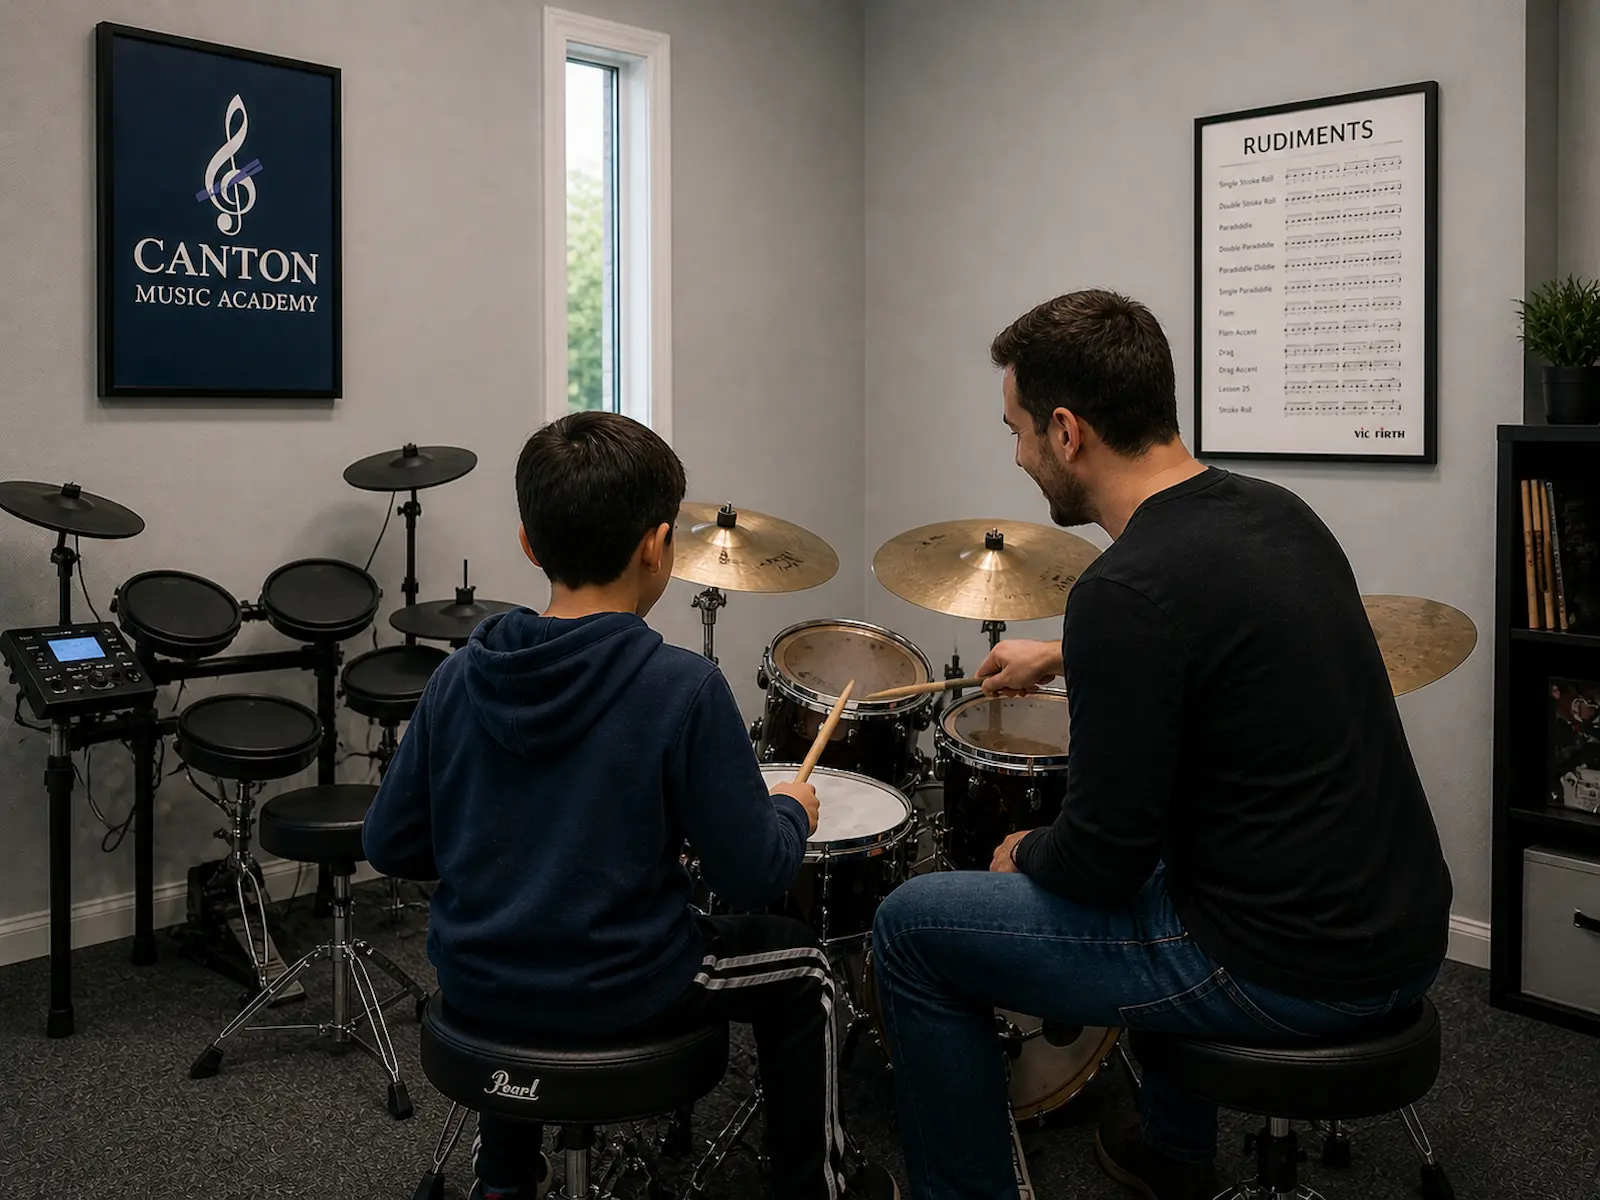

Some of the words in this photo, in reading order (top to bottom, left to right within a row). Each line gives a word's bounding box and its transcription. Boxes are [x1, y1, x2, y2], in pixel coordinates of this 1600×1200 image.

[1243, 119, 1374, 155] RUDIMENTS
[1219, 201, 1241, 210] Double
[1219, 244, 1241, 253] Double
[133, 237, 319, 285] CANTON
[135, 284, 211, 307] MUSIC
[217, 290, 318, 313] ACADEMY
[1236, 328, 1257, 336] Accent
[1219, 349, 1234, 358] Drag
[1219, 366, 1234, 375] Drag
[1236, 366, 1258, 374] Accent
[483, 1070, 540, 1100] Pearl
